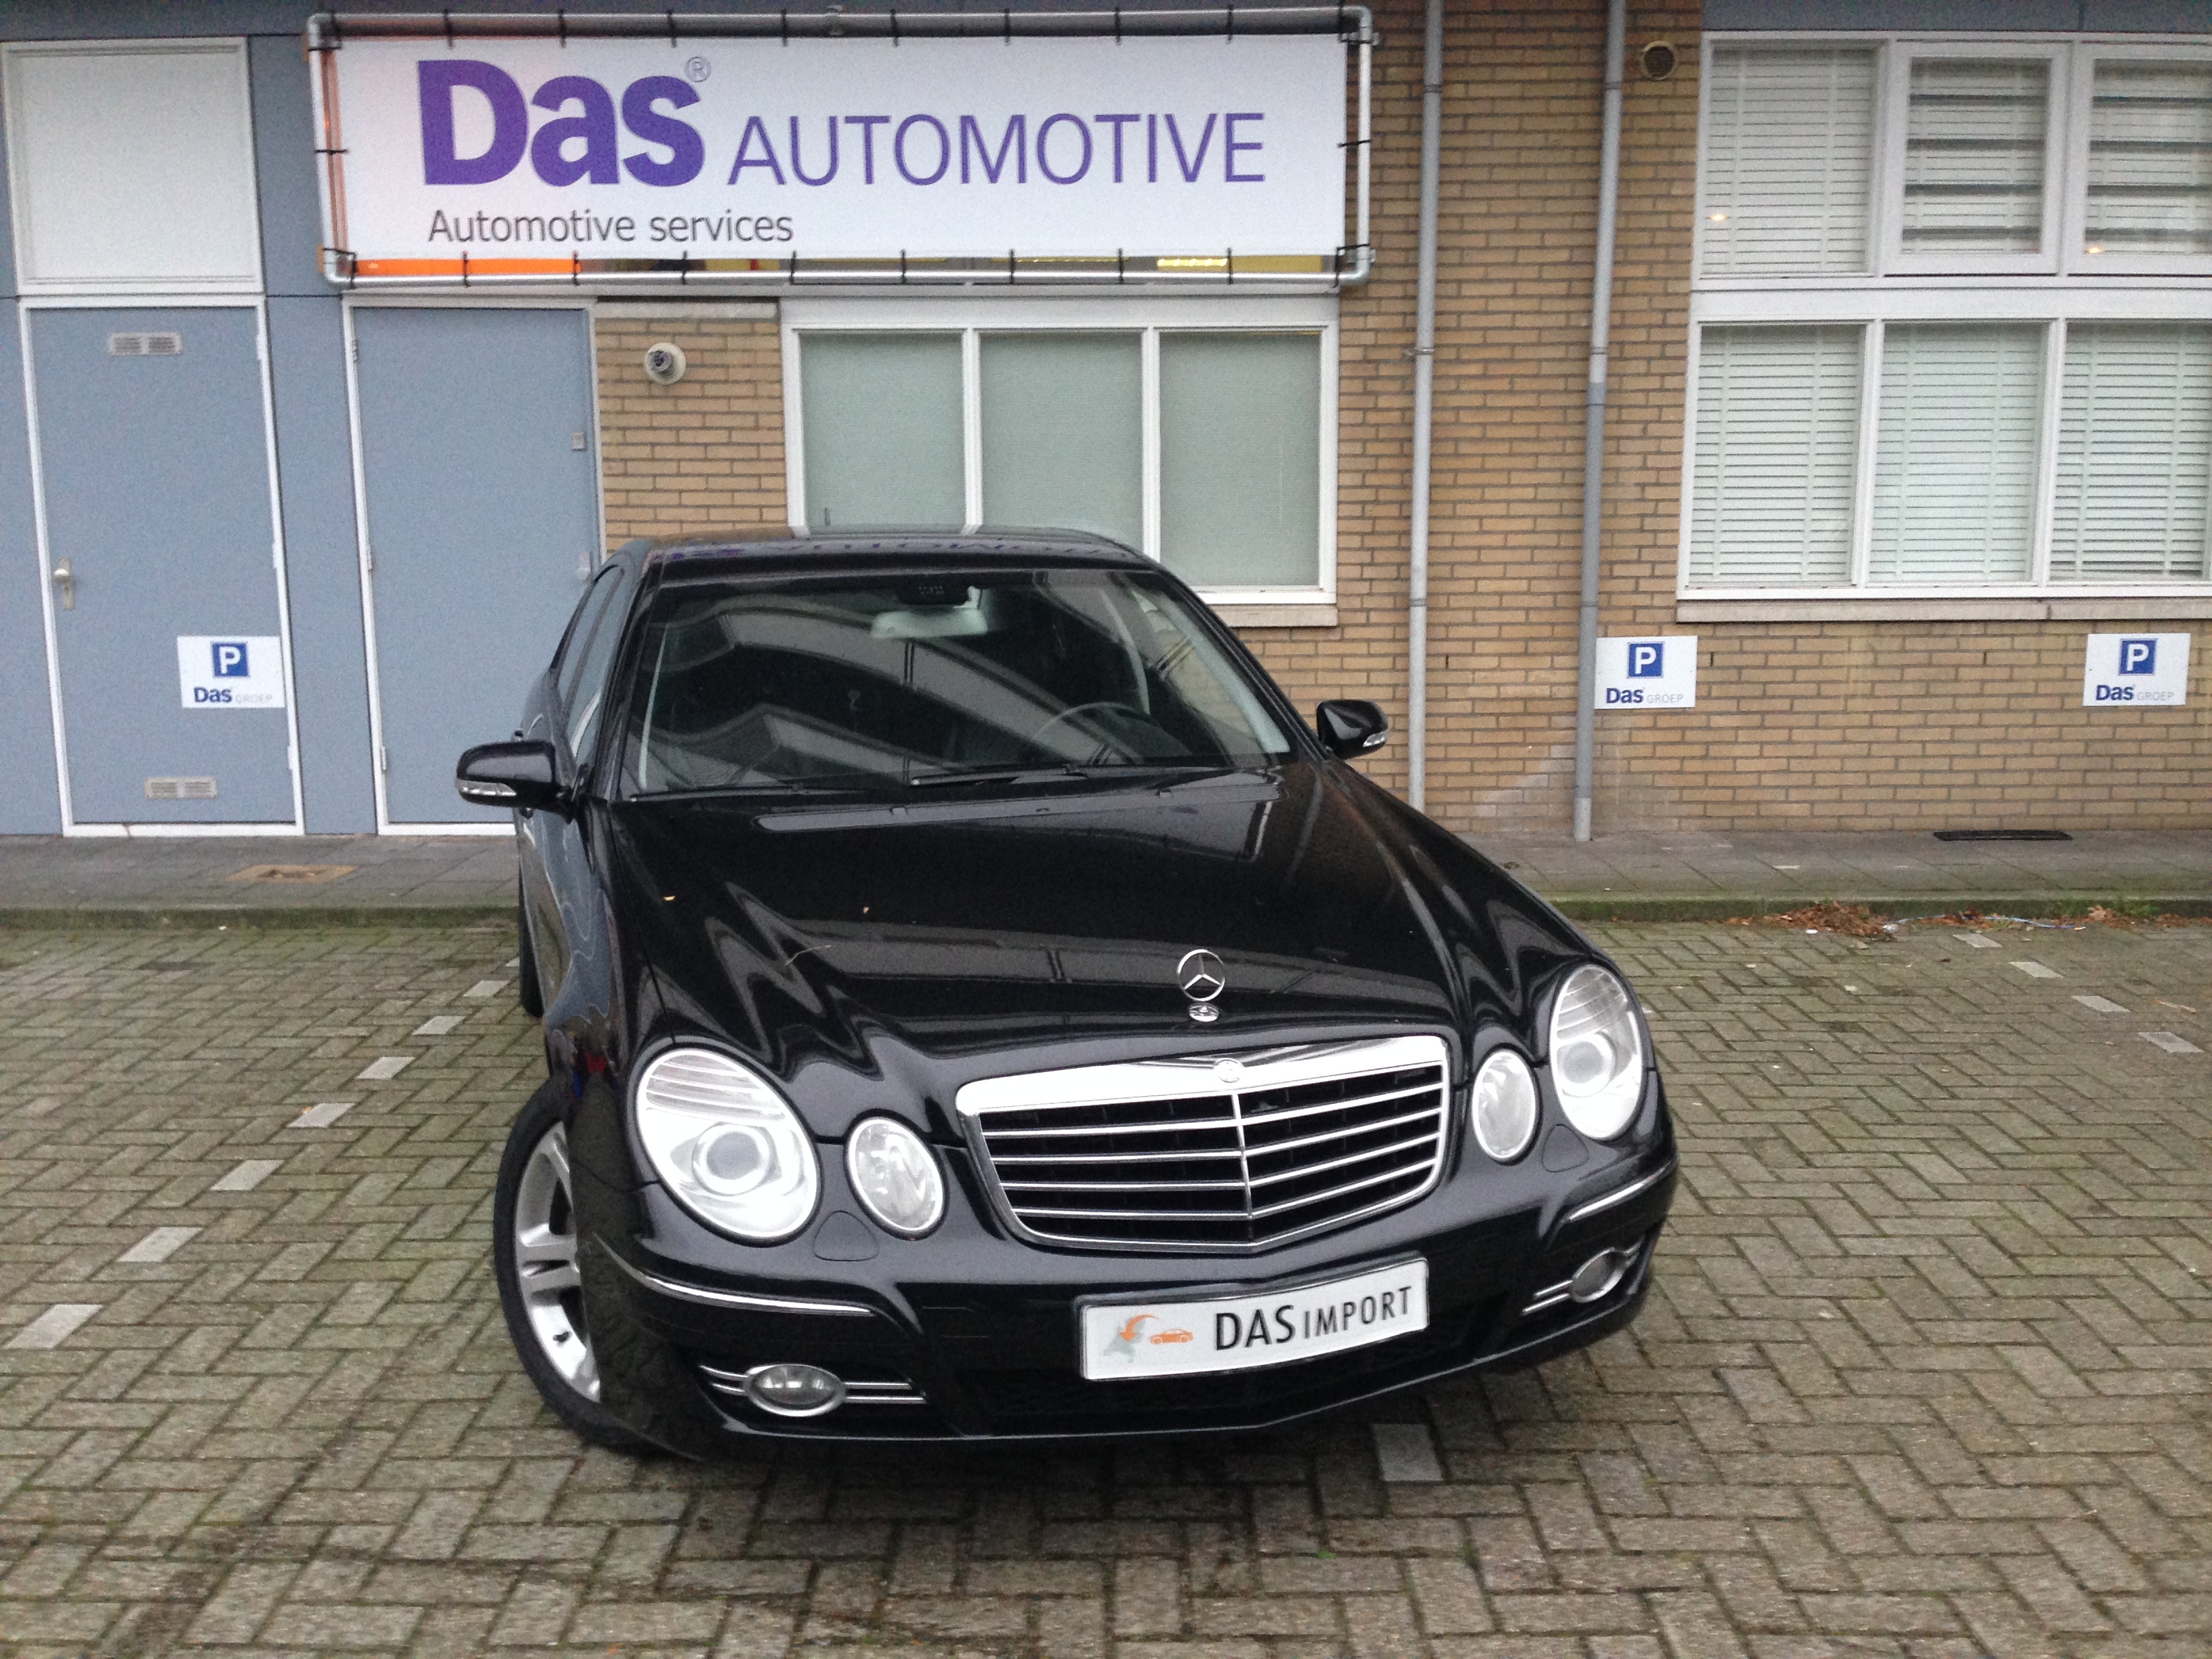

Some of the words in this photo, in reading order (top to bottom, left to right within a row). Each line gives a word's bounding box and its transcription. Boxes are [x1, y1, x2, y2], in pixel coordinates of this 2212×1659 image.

[417, 60, 705, 187] Das
[727, 113, 1265, 186] AUTOMOTIVE
[429, 209, 636, 243] Automotive
[650, 210, 793, 242] services
[219, 647, 241, 674] P
[1635, 647, 1656, 674] P
[2127, 644, 2150, 671] P
[194, 687, 232, 703] Das
[1606, 688, 1643, 703] Das
[1647, 694, 1683, 703] GROEP
[2096, 684, 2134, 701] Das
[2137, 692, 2175, 701] GROEP
[1216, 1305, 1296, 1351] DAS
[1303, 1287, 1412, 1339] IMPORT
